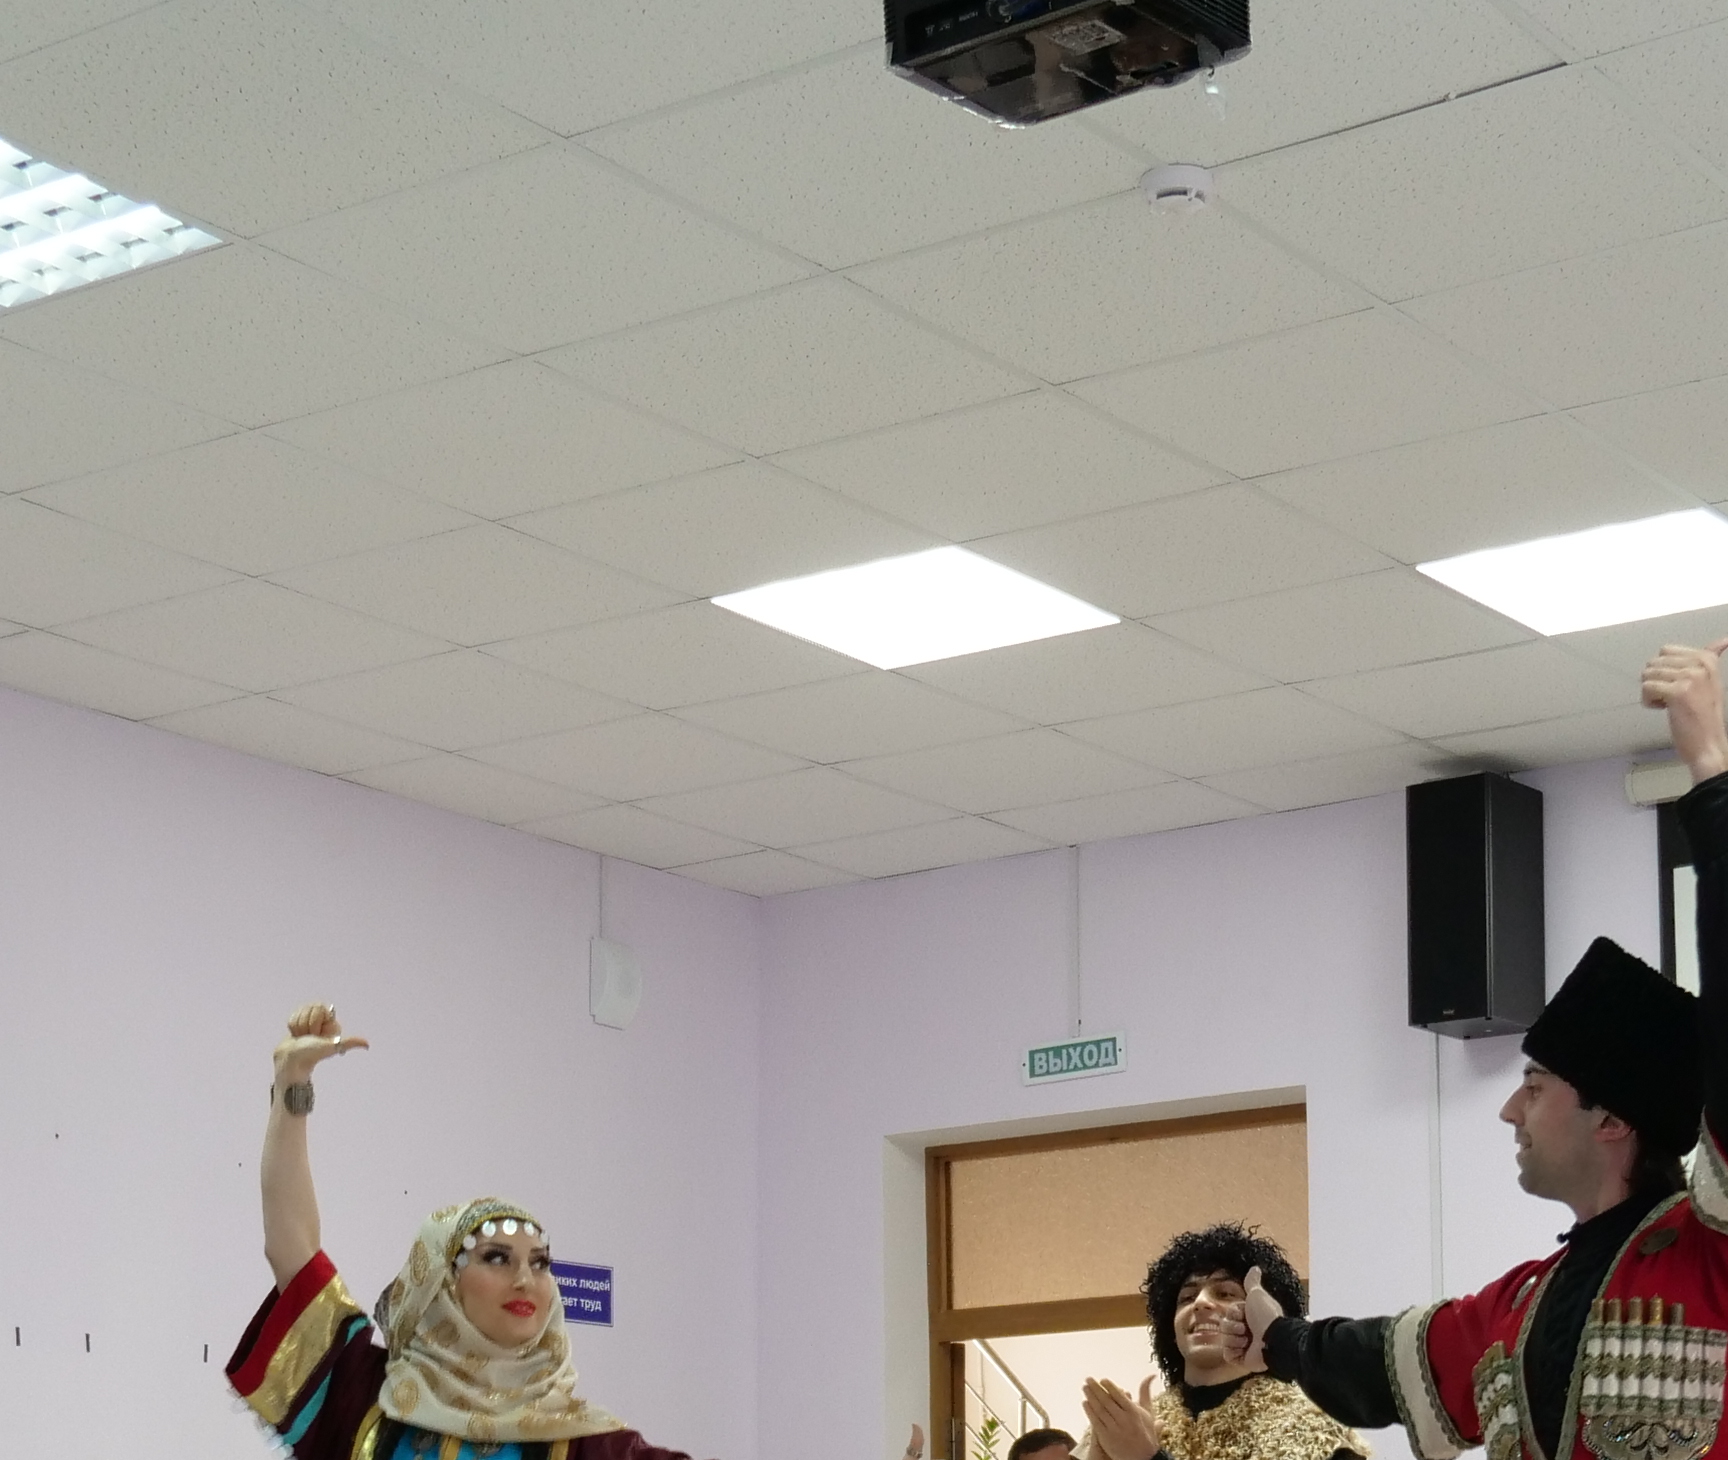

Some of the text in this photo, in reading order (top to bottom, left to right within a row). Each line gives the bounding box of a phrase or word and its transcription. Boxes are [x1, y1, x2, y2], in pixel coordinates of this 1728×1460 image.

[1033, 1041, 1115, 1076] ВЫХОД
[579, 1278, 610, 1292] людей
[580, 1298, 602, 1312] труд
